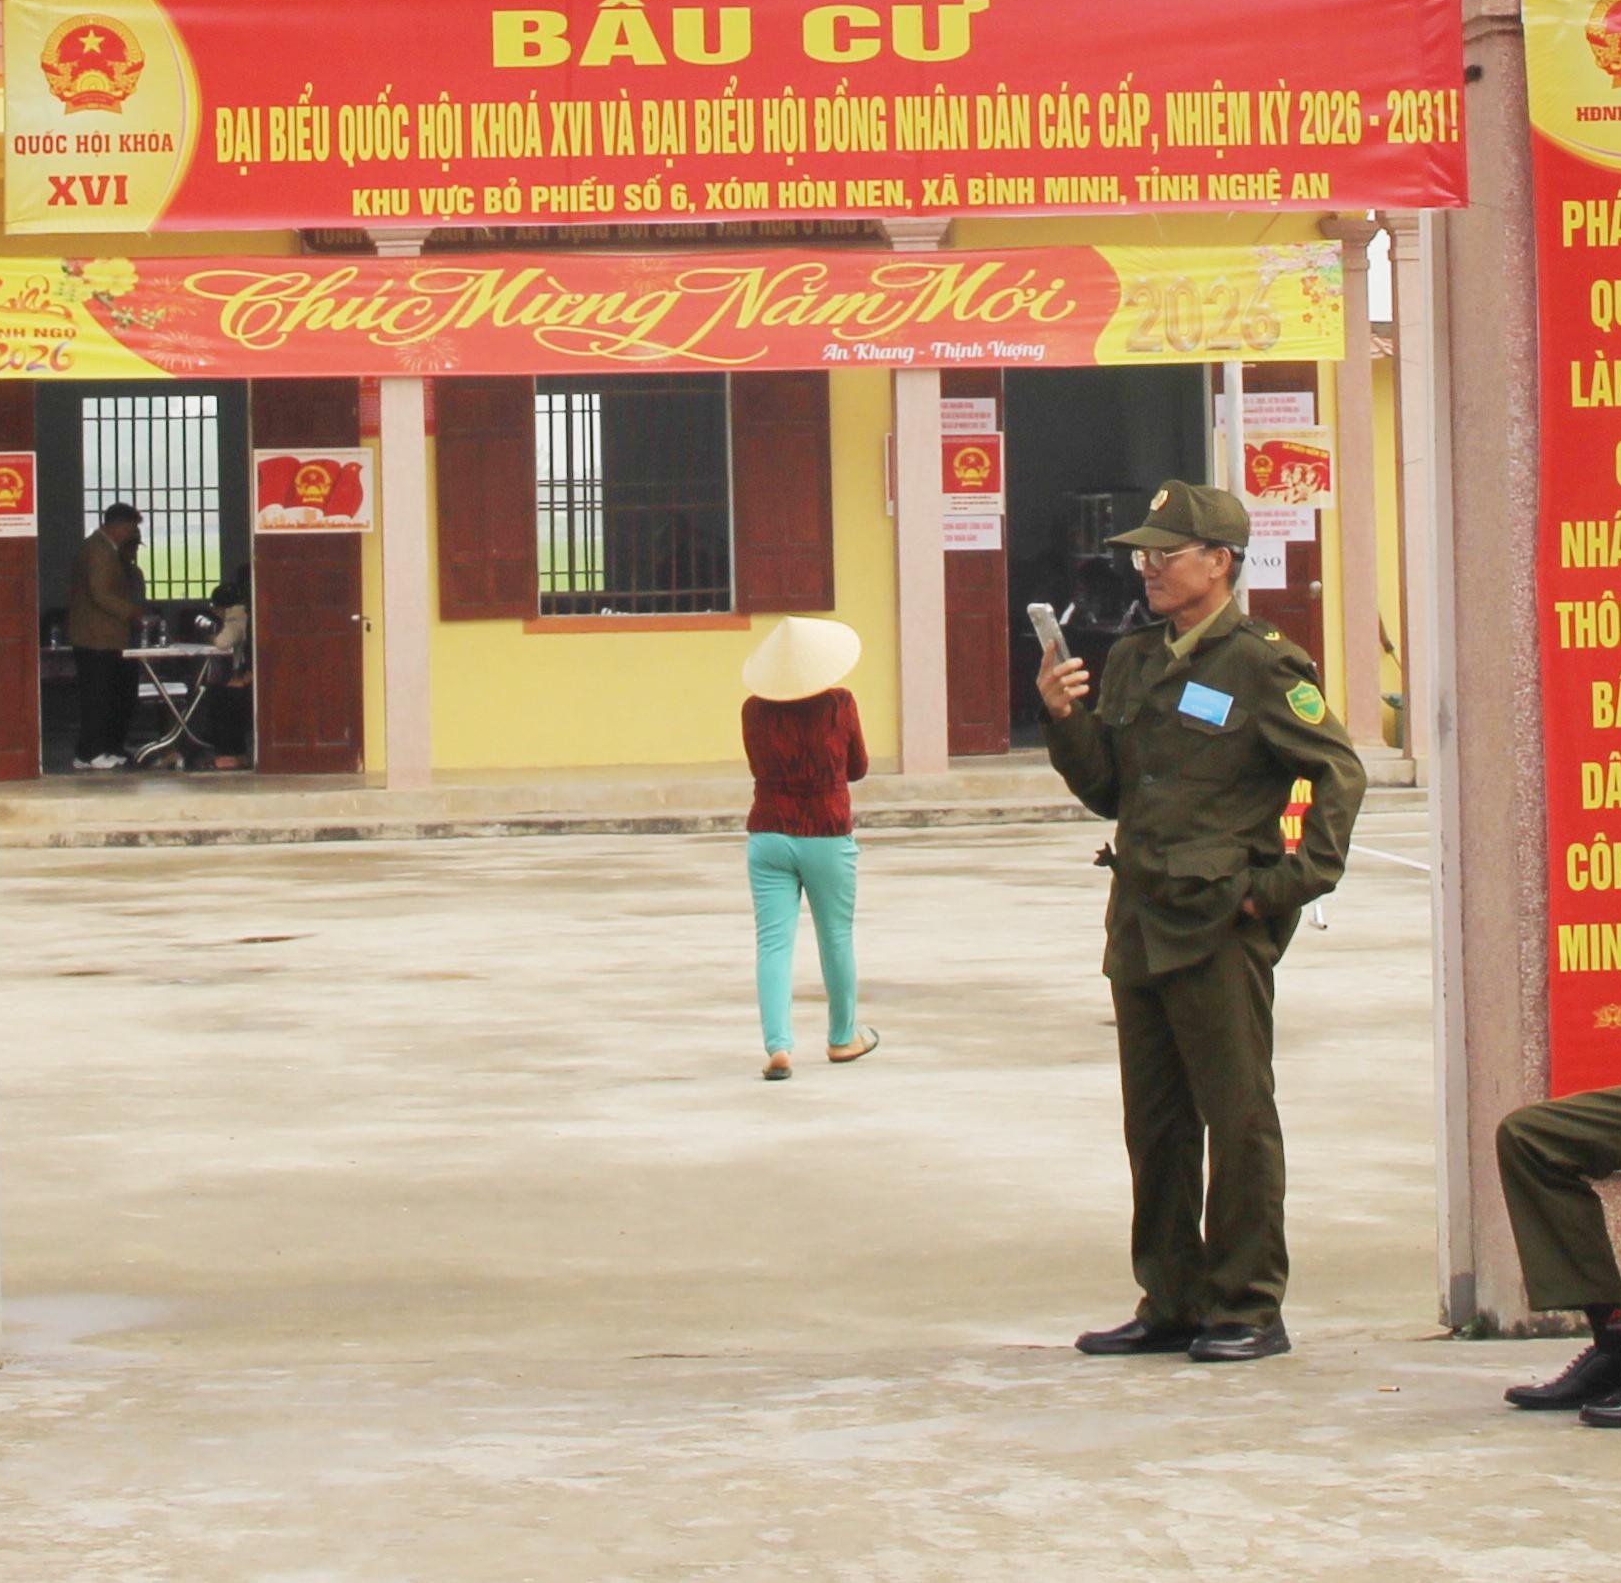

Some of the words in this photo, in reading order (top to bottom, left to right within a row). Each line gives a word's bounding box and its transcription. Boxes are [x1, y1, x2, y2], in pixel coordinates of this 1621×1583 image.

[13, 133, 68, 156] QUỐC
[75, 133, 111, 156] HỘI
[119, 132, 174, 153] KHÓA
[215, 106, 261, 176] ĐẠI
[268, 82, 331, 162] BIỂU
[338, 84, 410, 167] QUỐC
[417, 91, 463, 173] HỘI
[470, 89, 544, 159] KHOÁ
[549, 100, 593, 158] XVI
[599, 88, 636, 157] VÀ
[641, 99, 687, 168] ĐẠI
[694, 75, 755, 155] BIỂU
[762, 85, 807, 166] HỘI
[813, 77, 888, 153] ĐỒNG
[894, 83, 970, 152] NHÂN
[975, 82, 1032, 150] DÂN
[1037, 82, 1091, 150] CÁC
[1098, 72, 1159, 153] CẤP,
[1165, 79, 1252, 160] NHIỆM
[1258, 79, 1292, 146] KỲ
[1298, 90, 1363, 146] 2026
[1368, 114, 1380, 127] -
[1386, 89, 1459, 145] 2031!
[47, 173, 129, 207] XVI
[352, 188, 411, 217] KHU
[418, 184, 475, 220] VỰC
[483, 176, 523, 215] BỎ
[530, 177, 615, 214] PHIẾU
[623, 174, 662, 212] SỐ
[669, 182, 697, 213] 6,
[704, 176, 770, 210] XÓM
[777, 175, 837, 209] HÒN
[845, 179, 913, 209] NEN,
[921, 173, 960, 207] XÃ
[967, 172, 1036, 206] BÌNH
[1043, 175, 1129, 205] MINH,
[1135, 166, 1201, 203] TỈNH
[1207, 167, 1283, 204] NGHỆ
[1290, 172, 1331, 201] AN
[184, 266, 428, 351] Chúc
[370, 267, 688, 363] Mừng
[675, 261, 908, 364] Năm
[830, 261, 1077, 341] Mới
[1122, 273, 1282, 355] 2026
[822, 342, 850, 362] An
[852, 342, 915, 368] Khang
[930, 339, 985, 364] Thịnh
[986, 338, 1046, 367] Vượng
[1250, 552, 1282, 567] VÀO
